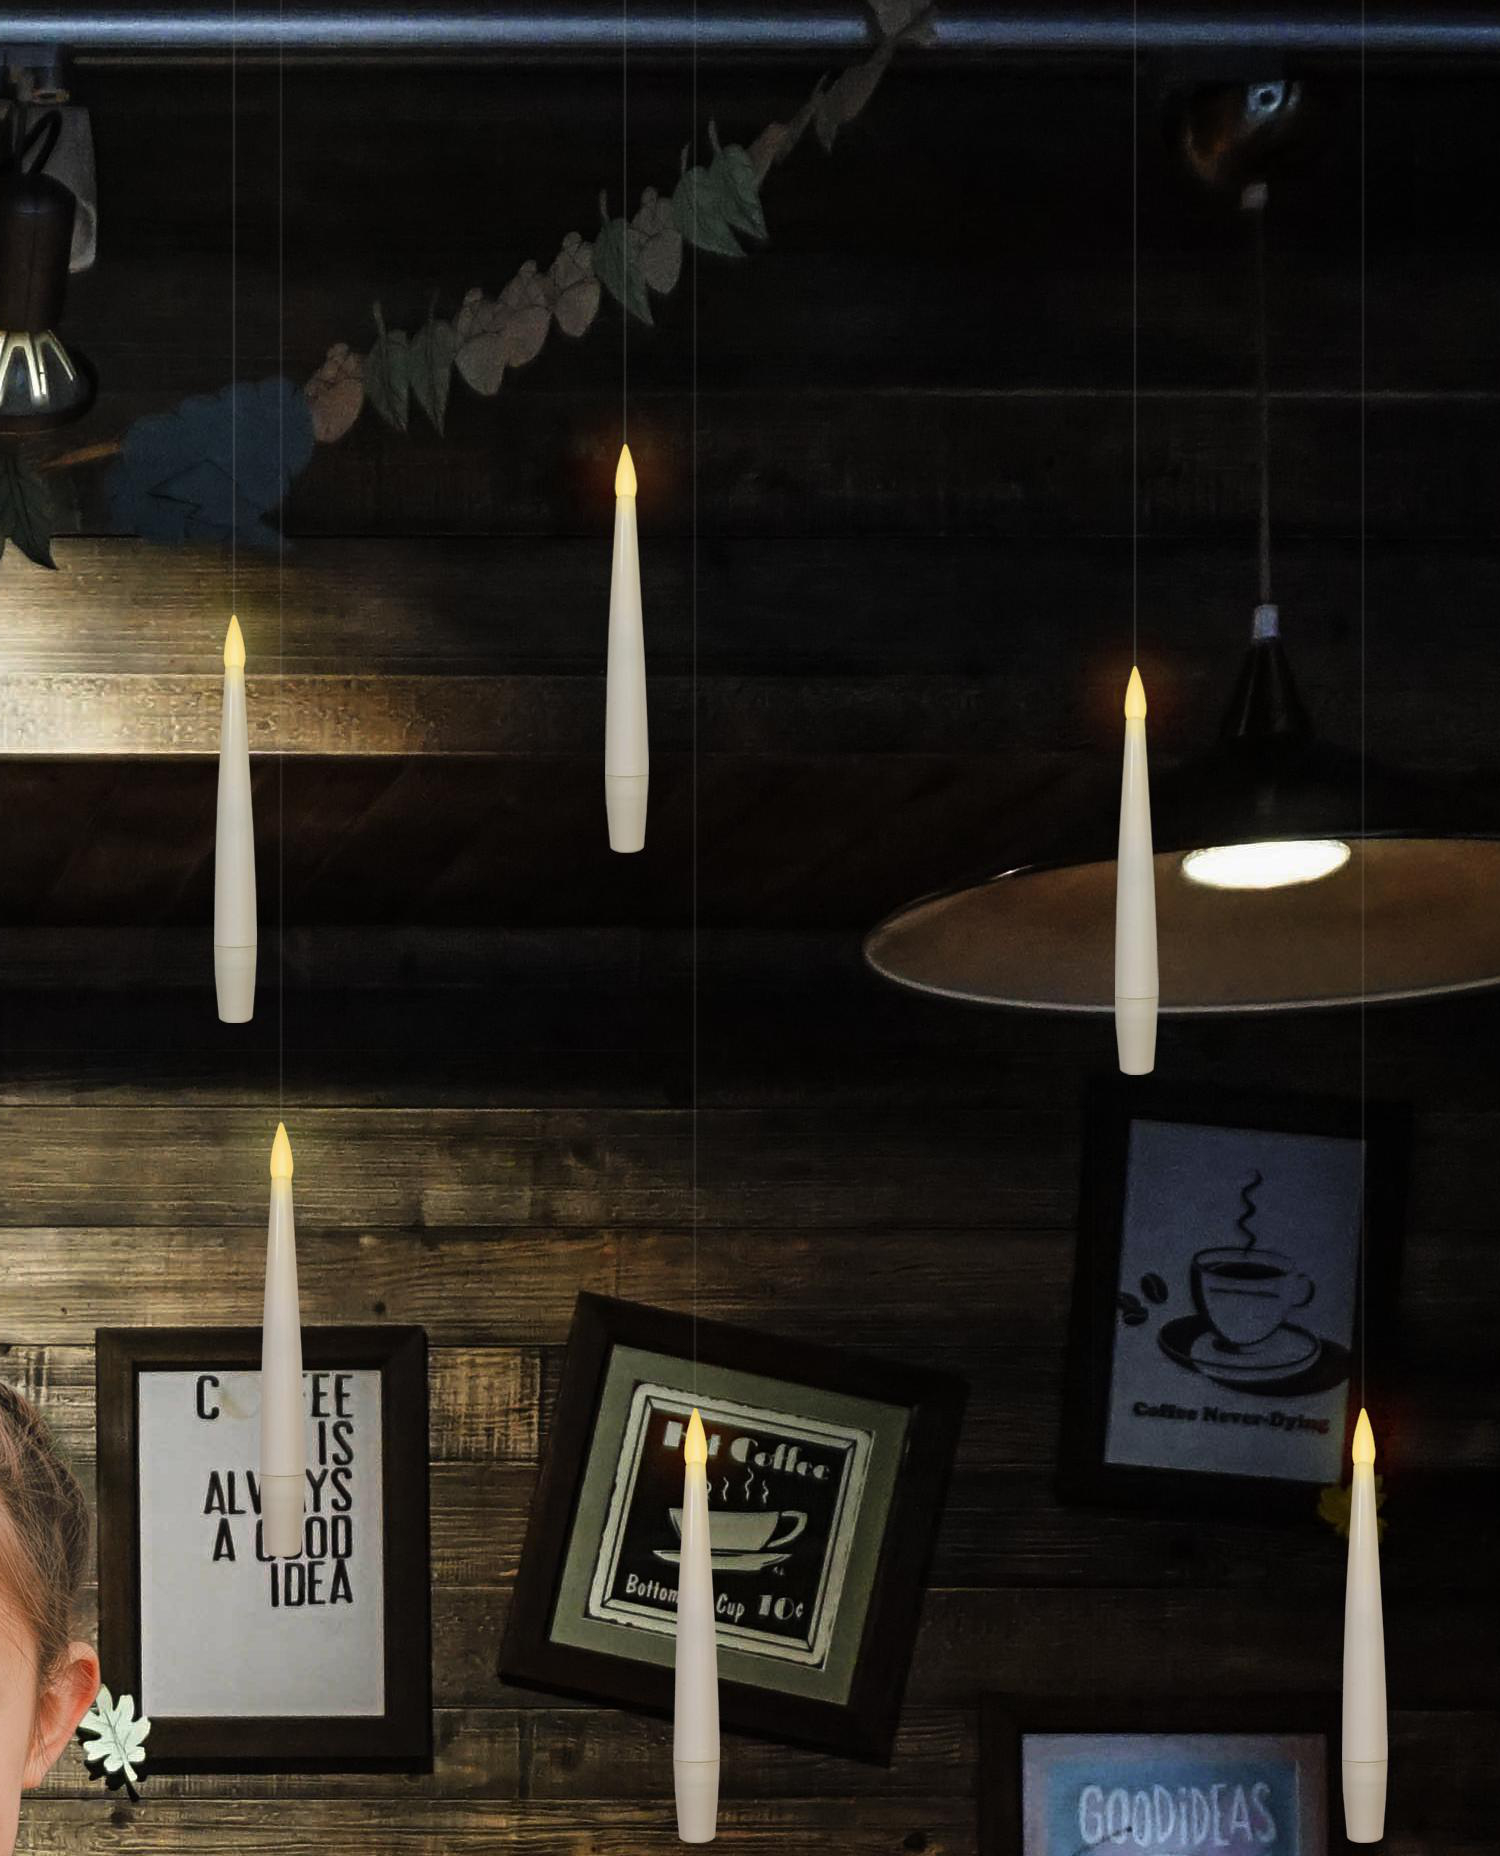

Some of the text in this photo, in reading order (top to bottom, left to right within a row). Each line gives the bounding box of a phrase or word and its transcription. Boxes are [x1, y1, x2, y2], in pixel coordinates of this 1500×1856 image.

[1133, 1402, 1197, 1420] Coffee
[318, 1420, 354, 1465] IS
[663, 1420, 831, 1480] Ht Coffee
[203, 1467, 353, 1515] ALYS
[212, 1517, 236, 1562] A
[271, 1559, 354, 1608] IDEA
[716, 1593, 744, 1623] Cup
